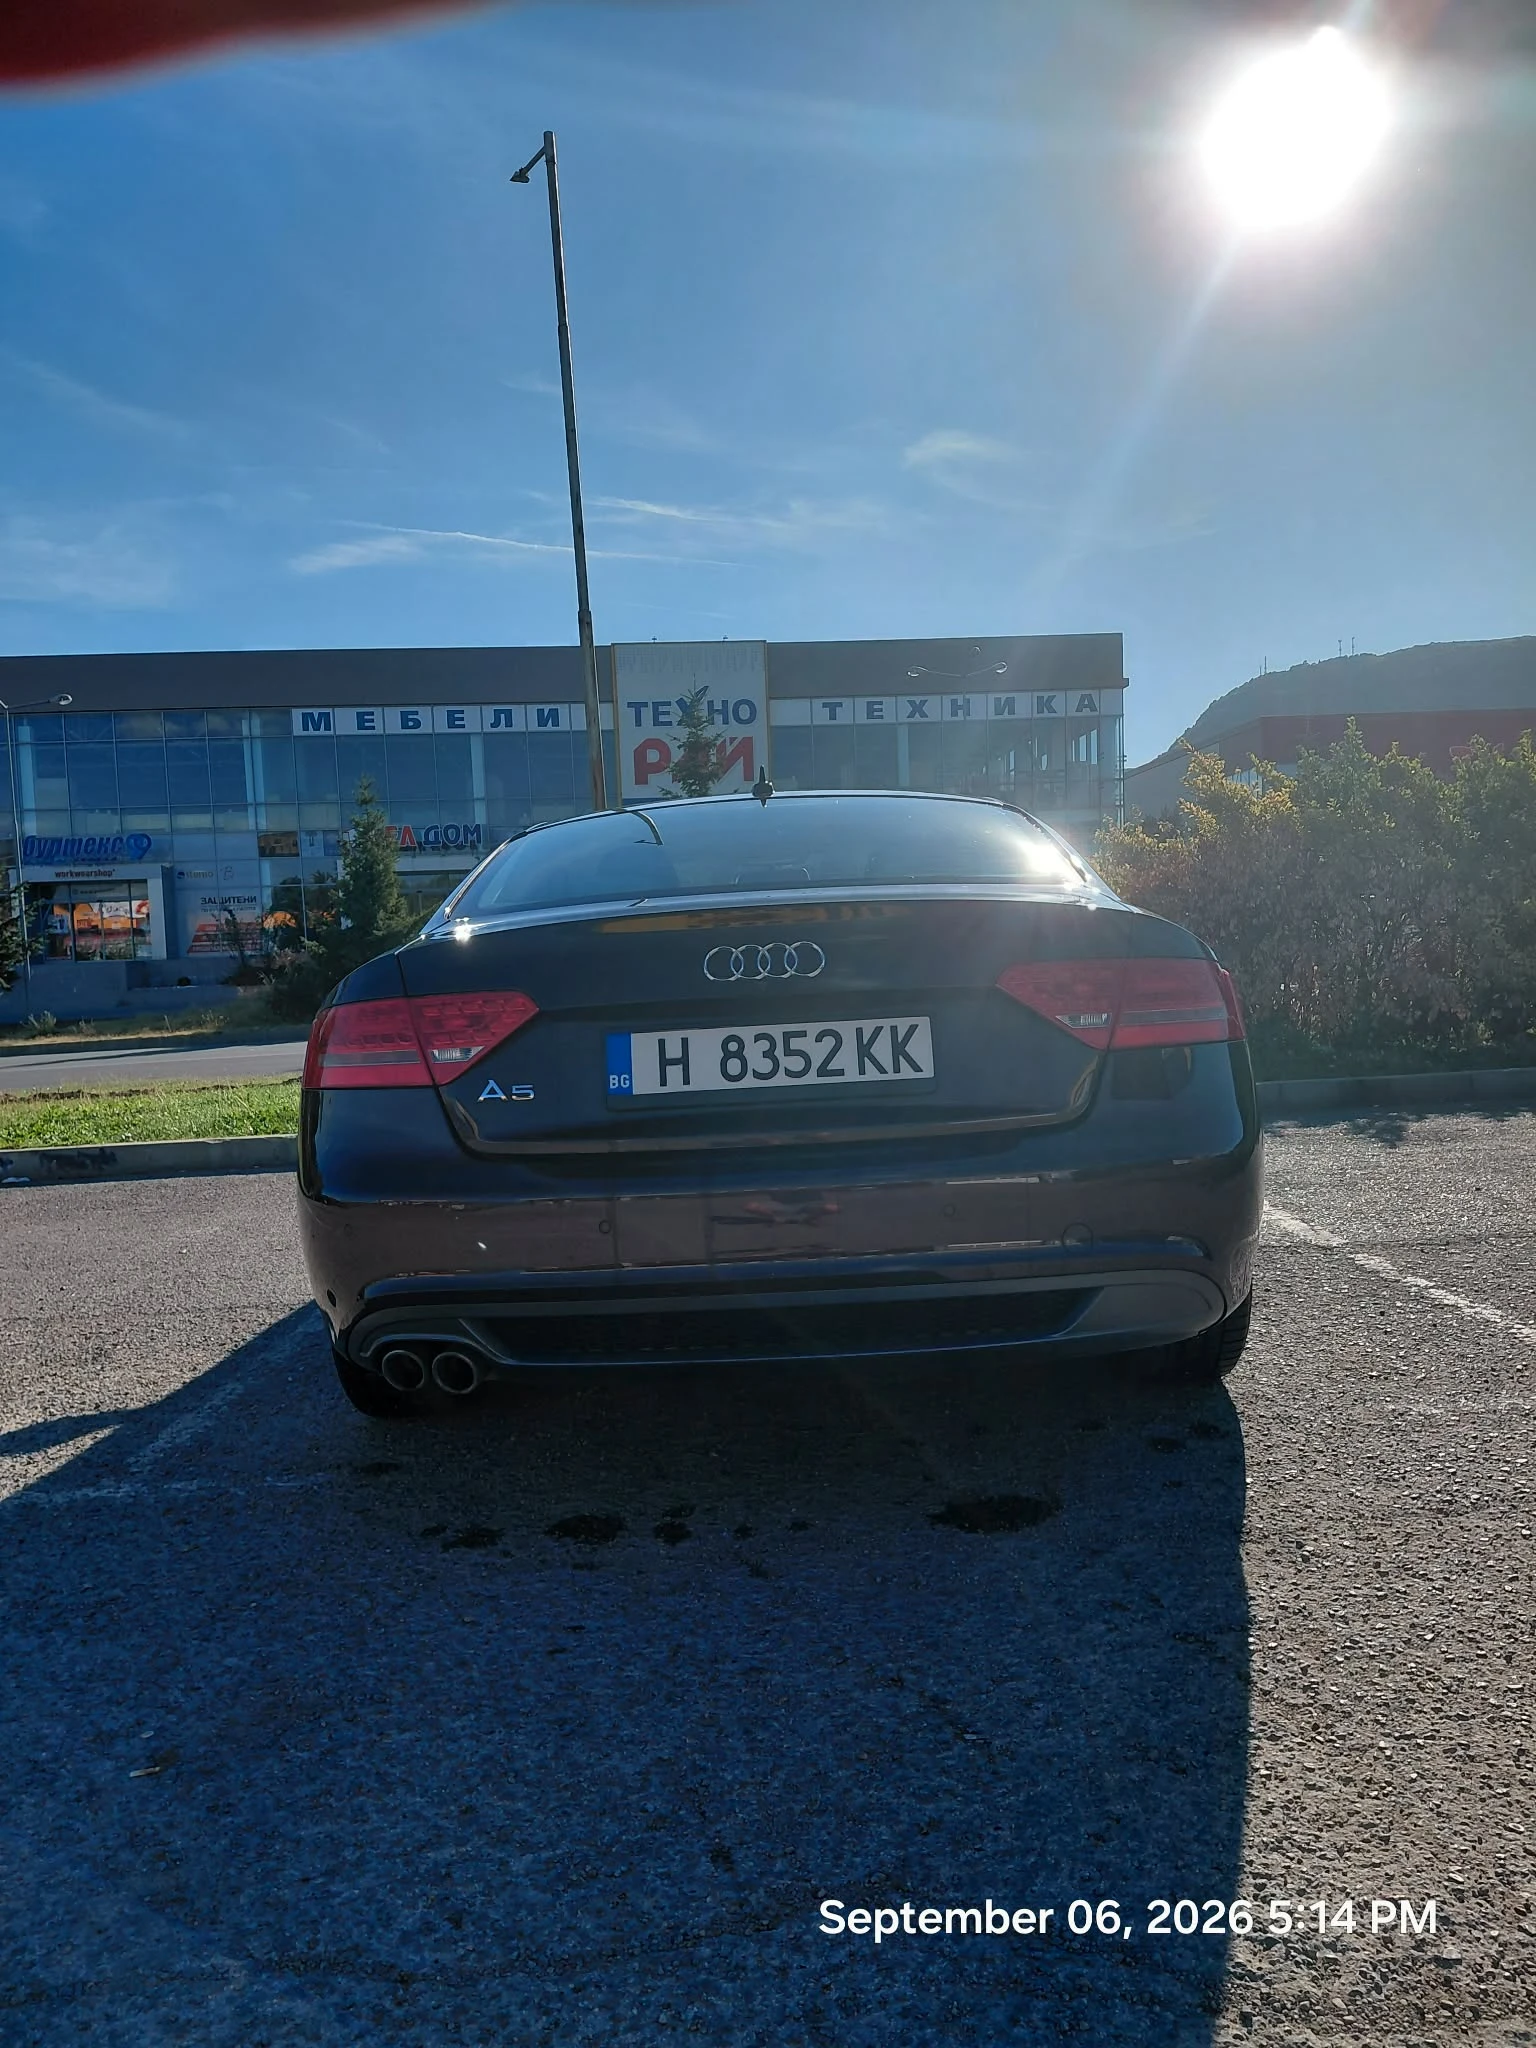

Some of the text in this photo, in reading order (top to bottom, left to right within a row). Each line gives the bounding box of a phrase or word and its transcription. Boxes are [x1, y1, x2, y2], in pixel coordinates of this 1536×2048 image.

[301, 708, 560, 732] МЕБЕЛИ
[627, 686, 758, 728] ТЕХНО
[821, 693, 1098, 721] ТЕХНИКА
[657, 1037, 691, 1087] H
[477, 1079, 535, 1102] A5
[609, 1074, 630, 1089] BG
